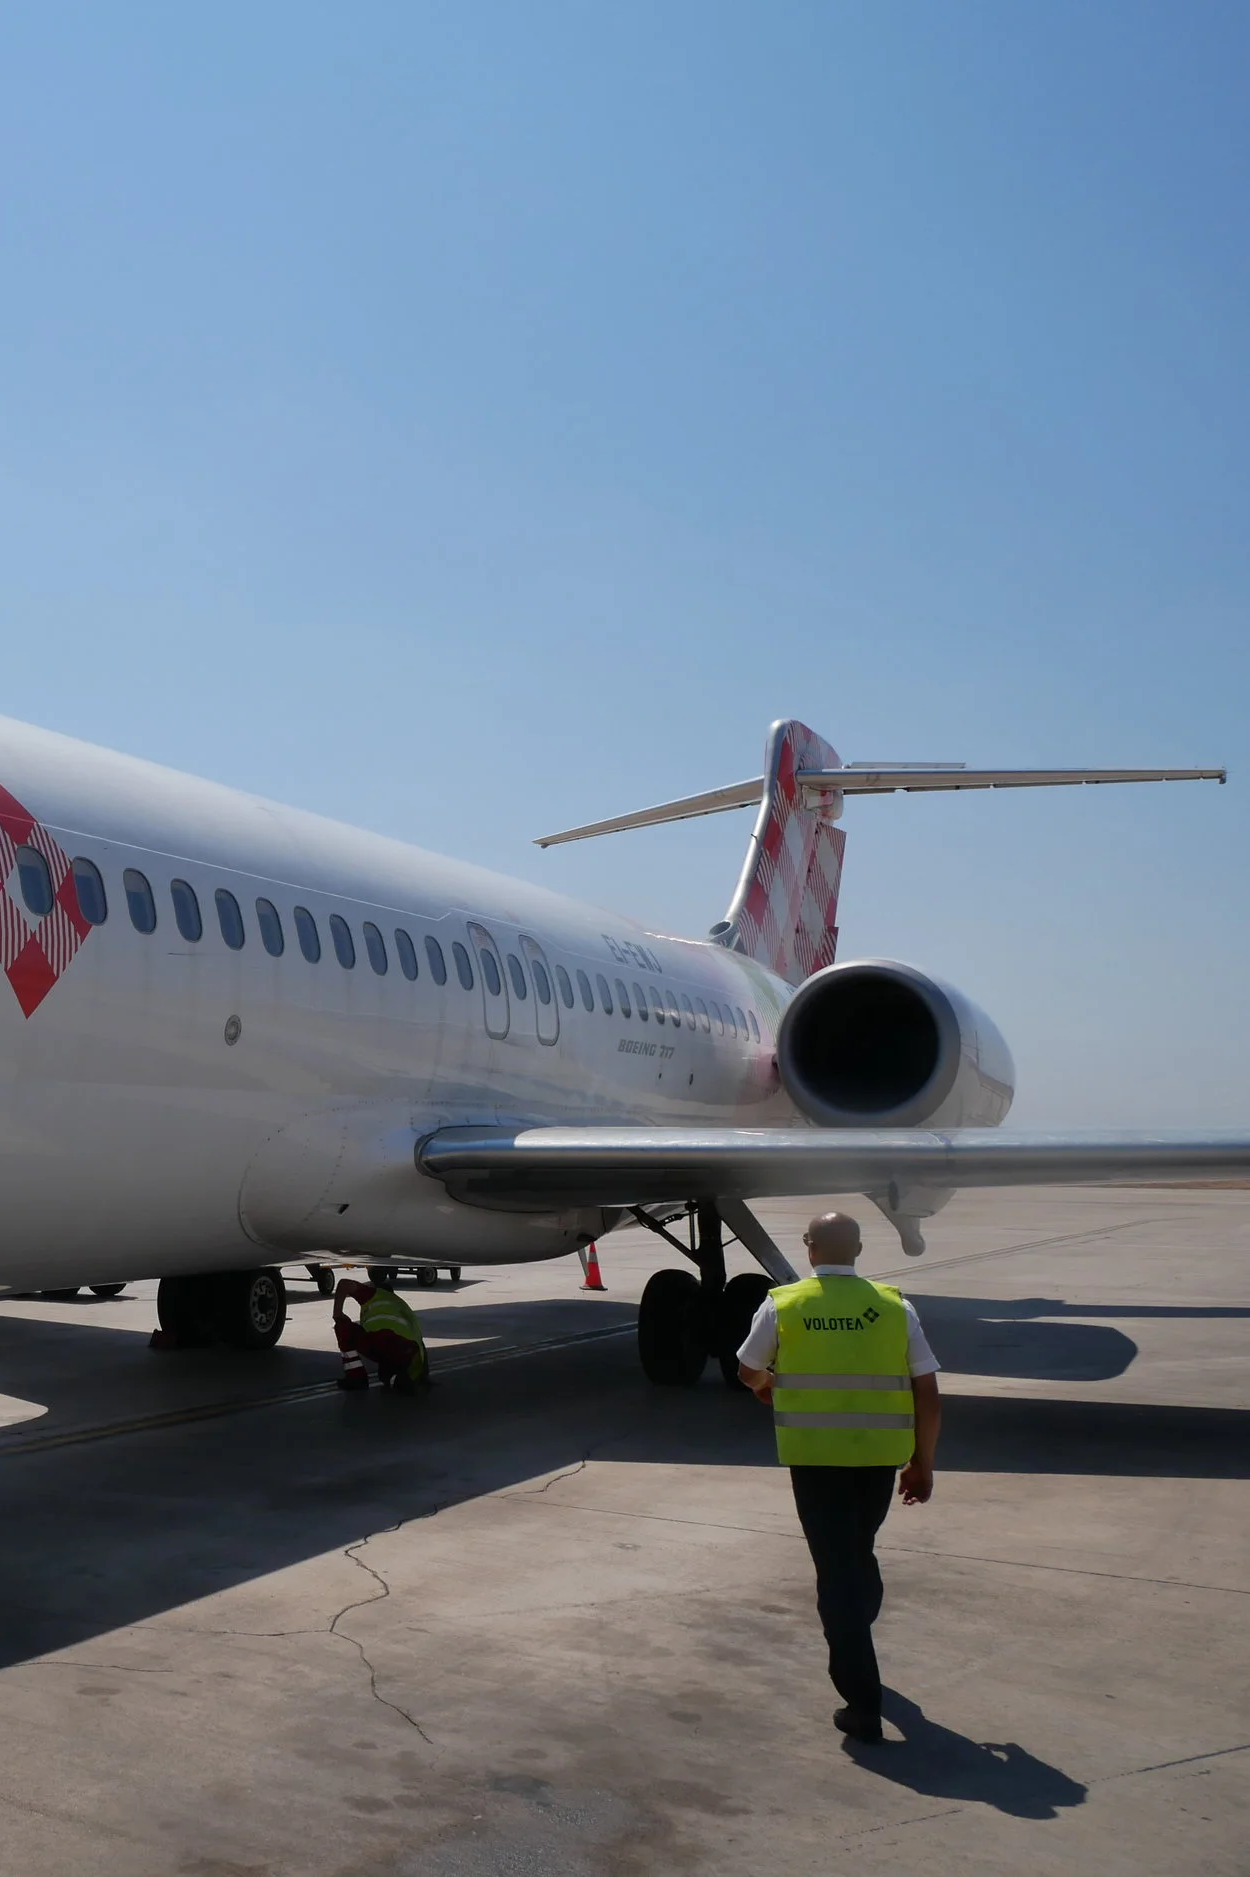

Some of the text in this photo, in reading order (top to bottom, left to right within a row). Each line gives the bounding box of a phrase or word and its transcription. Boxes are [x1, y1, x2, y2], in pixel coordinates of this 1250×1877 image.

[617, 1038, 676, 1060] BOEING 717
[802, 1317, 865, 1331] VOLOTEA
